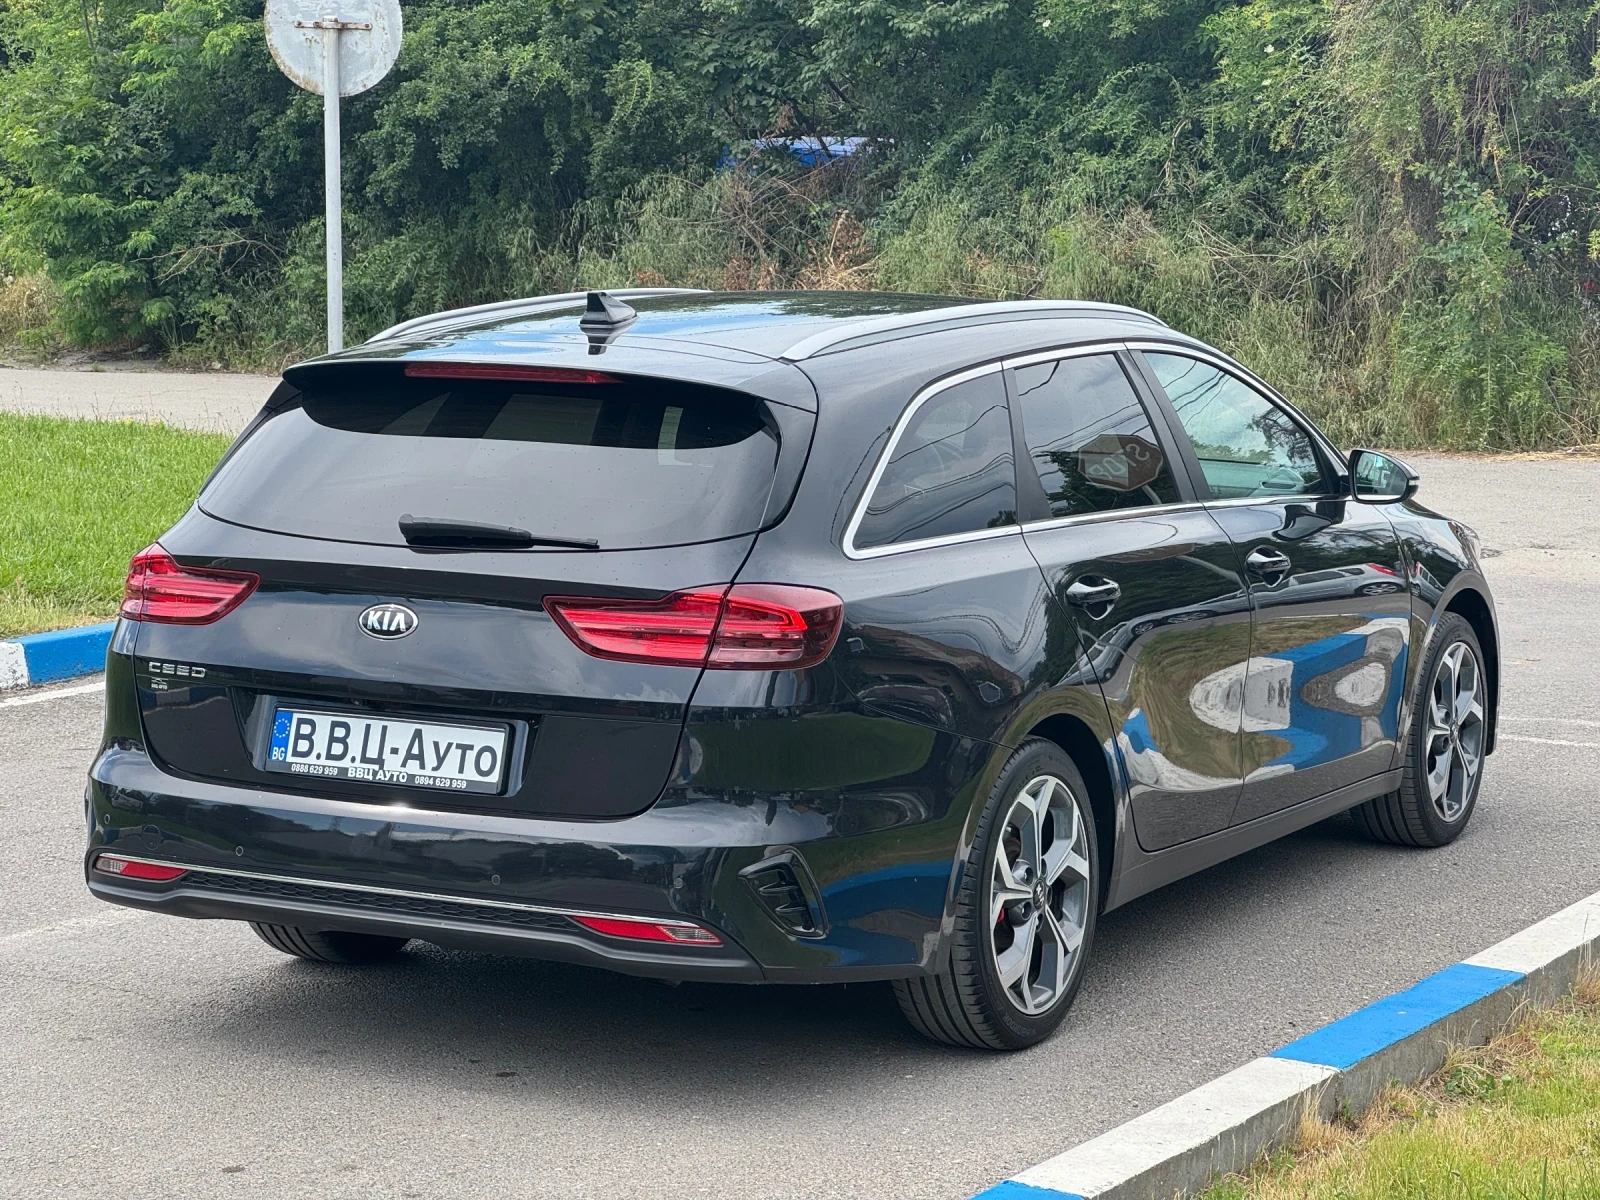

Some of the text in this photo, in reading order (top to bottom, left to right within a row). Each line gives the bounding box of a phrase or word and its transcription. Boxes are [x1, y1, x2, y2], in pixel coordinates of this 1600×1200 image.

[367, 611, 407, 631] KIA
[149, 661, 206, 678] CEED
[272, 746, 285, 761] BG
[291, 763, 338, 776] 0888 629 959
[348, 767, 408, 783] ВВЦ АУТО
[414, 776, 467, 789] 0894 629 959
